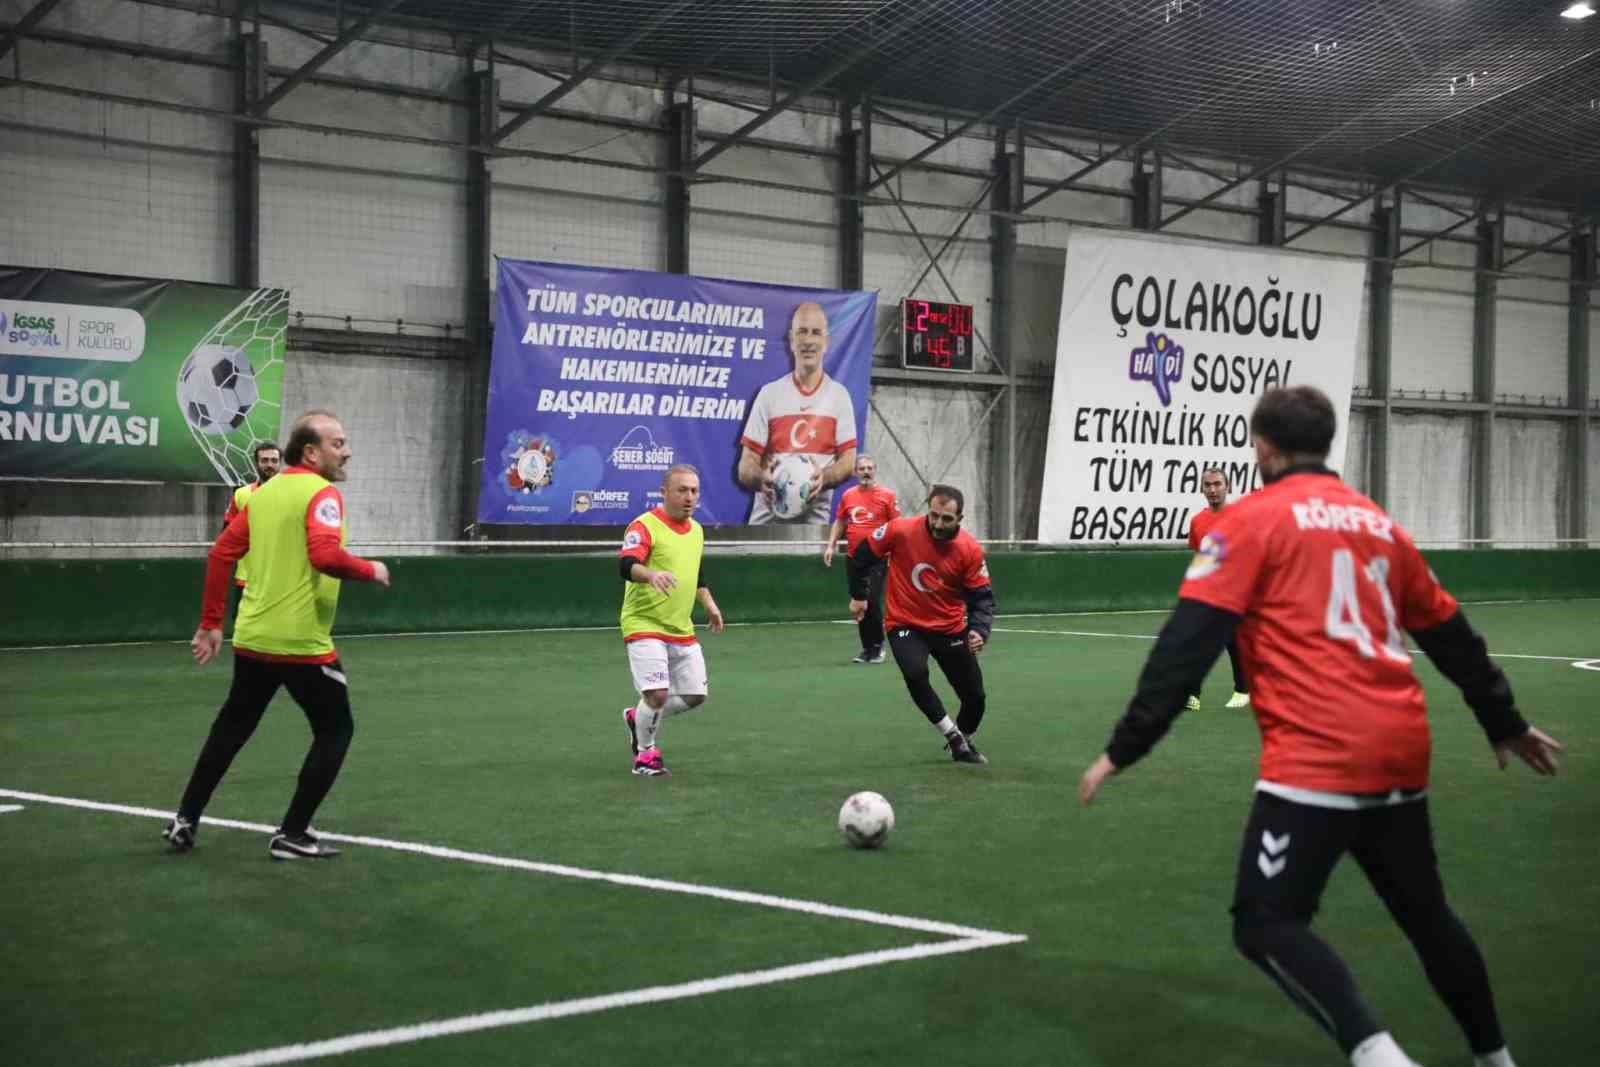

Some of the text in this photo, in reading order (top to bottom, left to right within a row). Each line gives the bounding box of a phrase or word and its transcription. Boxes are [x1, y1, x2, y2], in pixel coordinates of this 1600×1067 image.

[527, 284, 765, 329] TÜM SPORCULARIMIZA
[1110, 273, 1322, 341] ÇOLAKOĞLU
[79, 320, 115, 335] SPOR
[521, 322, 766, 360] ANTRENÖRLERİMİZE VE
[0, 374, 130, 410] UTBOL
[560, 357, 732, 388] HAKEMLERİMİZE
[537, 389, 746, 421] BAŞARILAR DİLERİM
[1073, 401, 1254, 448] ETKİNLİK KO
[1089, 449, 1153, 493] TÜM
[593, 489, 629, 501] KÖRFEZ
[1291, 497, 1394, 543] KÖRFEZ
[1325, 548, 1413, 664] 41
